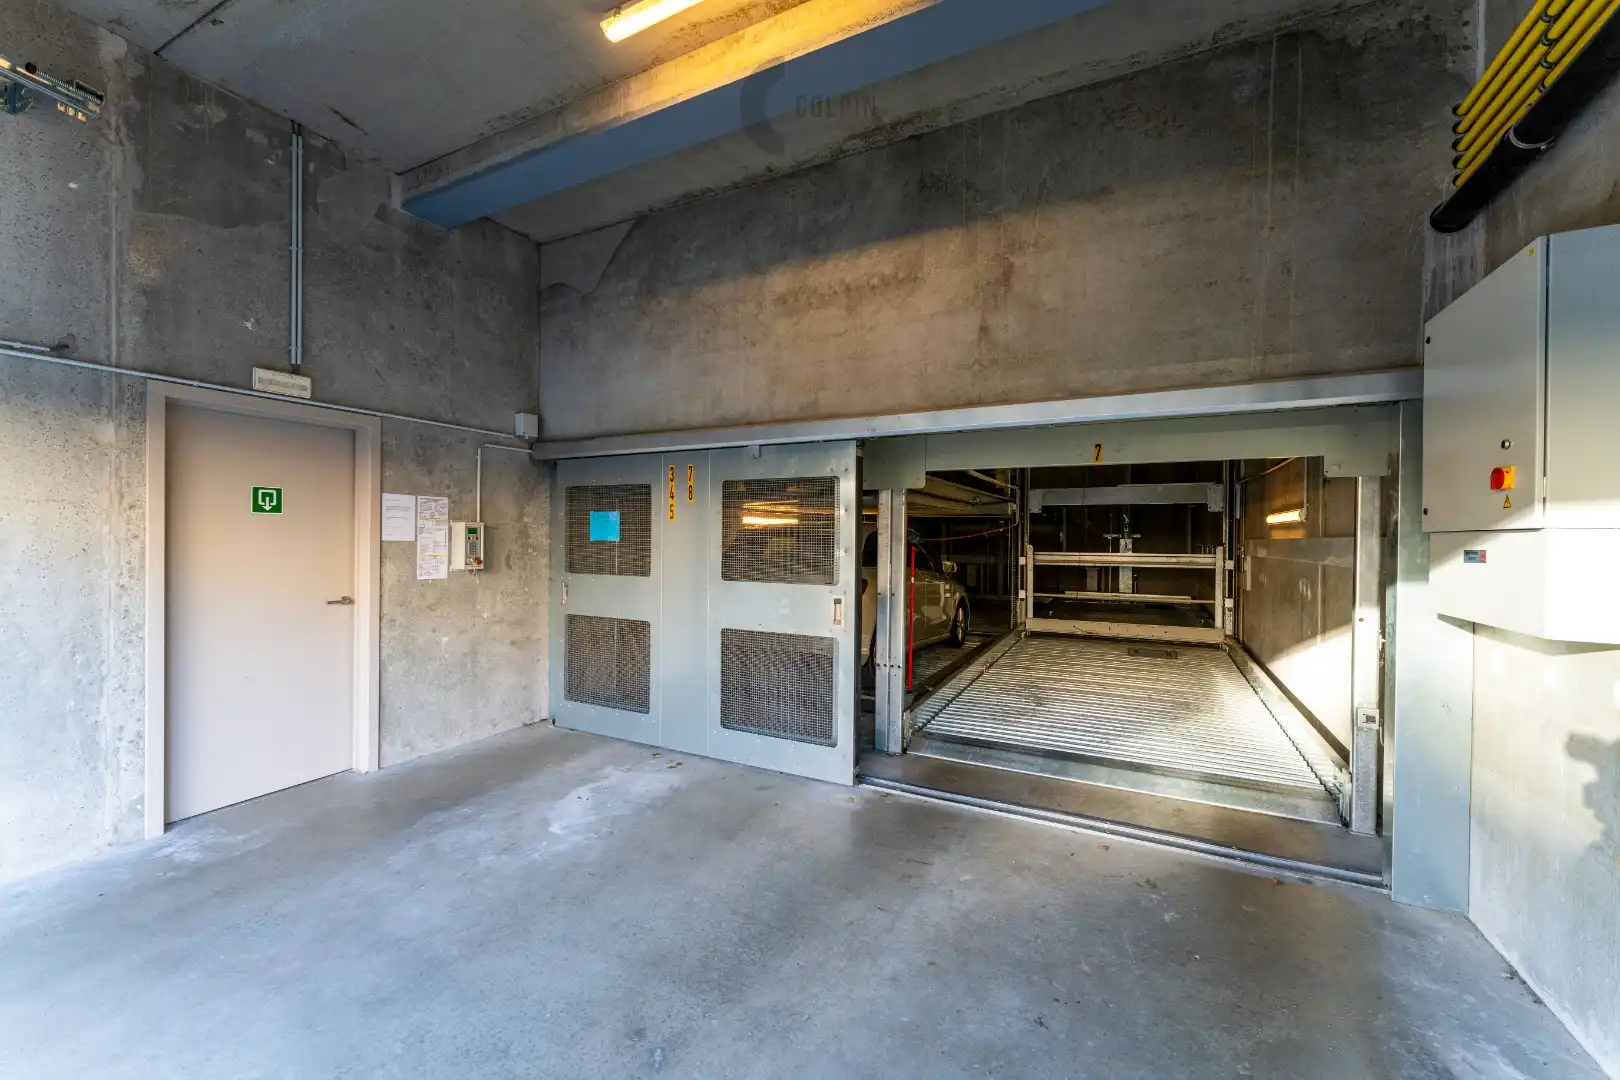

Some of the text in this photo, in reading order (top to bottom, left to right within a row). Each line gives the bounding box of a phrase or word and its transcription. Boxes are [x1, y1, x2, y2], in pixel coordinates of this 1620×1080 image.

[1094, 443, 1102, 462] 7
[669, 466, 675, 482] 3
[688, 465, 693, 482] 7
[669, 485, 675, 500] 4
[688, 484, 693, 501] 8
[669, 504, 675, 520] 5
